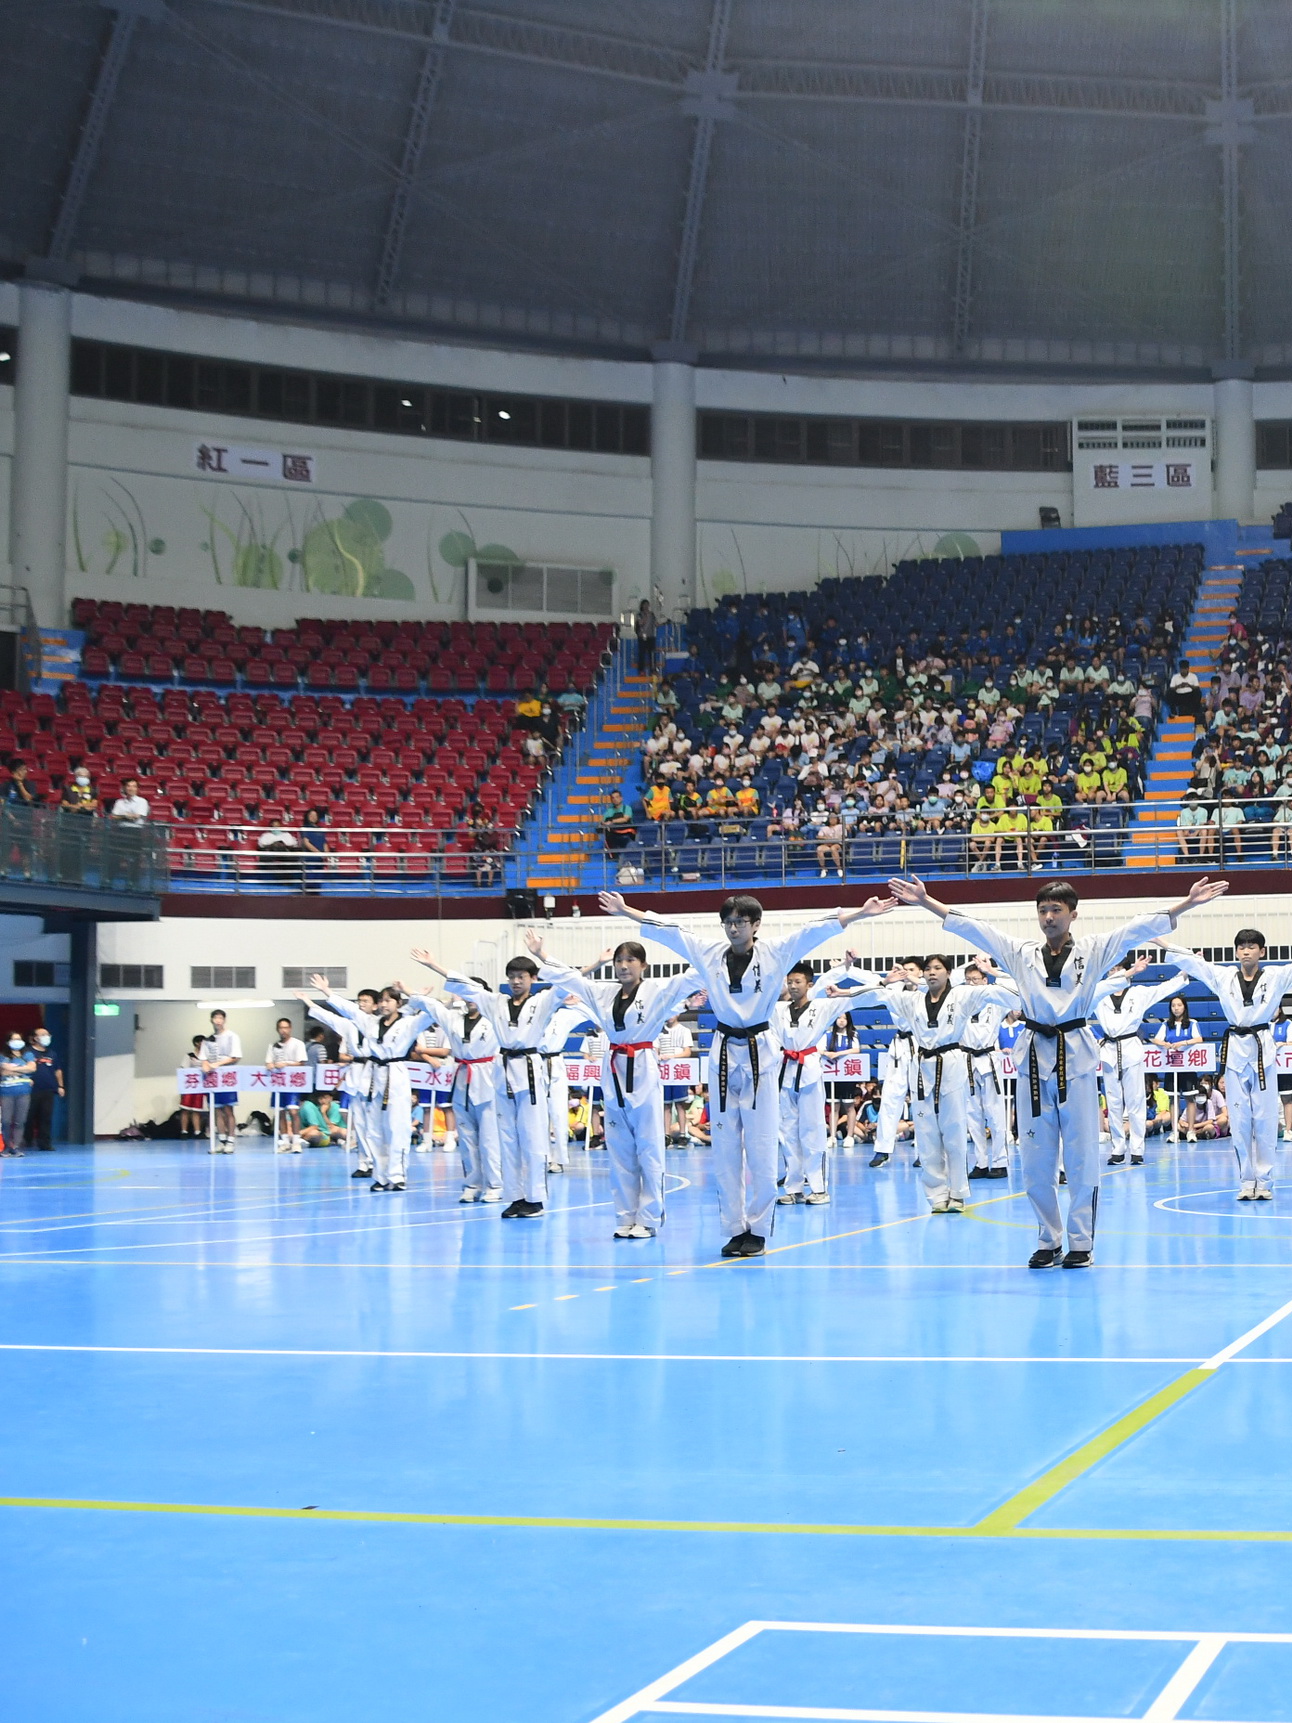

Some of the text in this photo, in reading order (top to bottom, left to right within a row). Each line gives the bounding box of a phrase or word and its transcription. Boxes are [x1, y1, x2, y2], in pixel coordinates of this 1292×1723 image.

[196, 444, 313, 482] 紅一區
[1094, 464, 1191, 488] 藍三區
[1143, 1049, 1208, 1068] 花壇鄉
